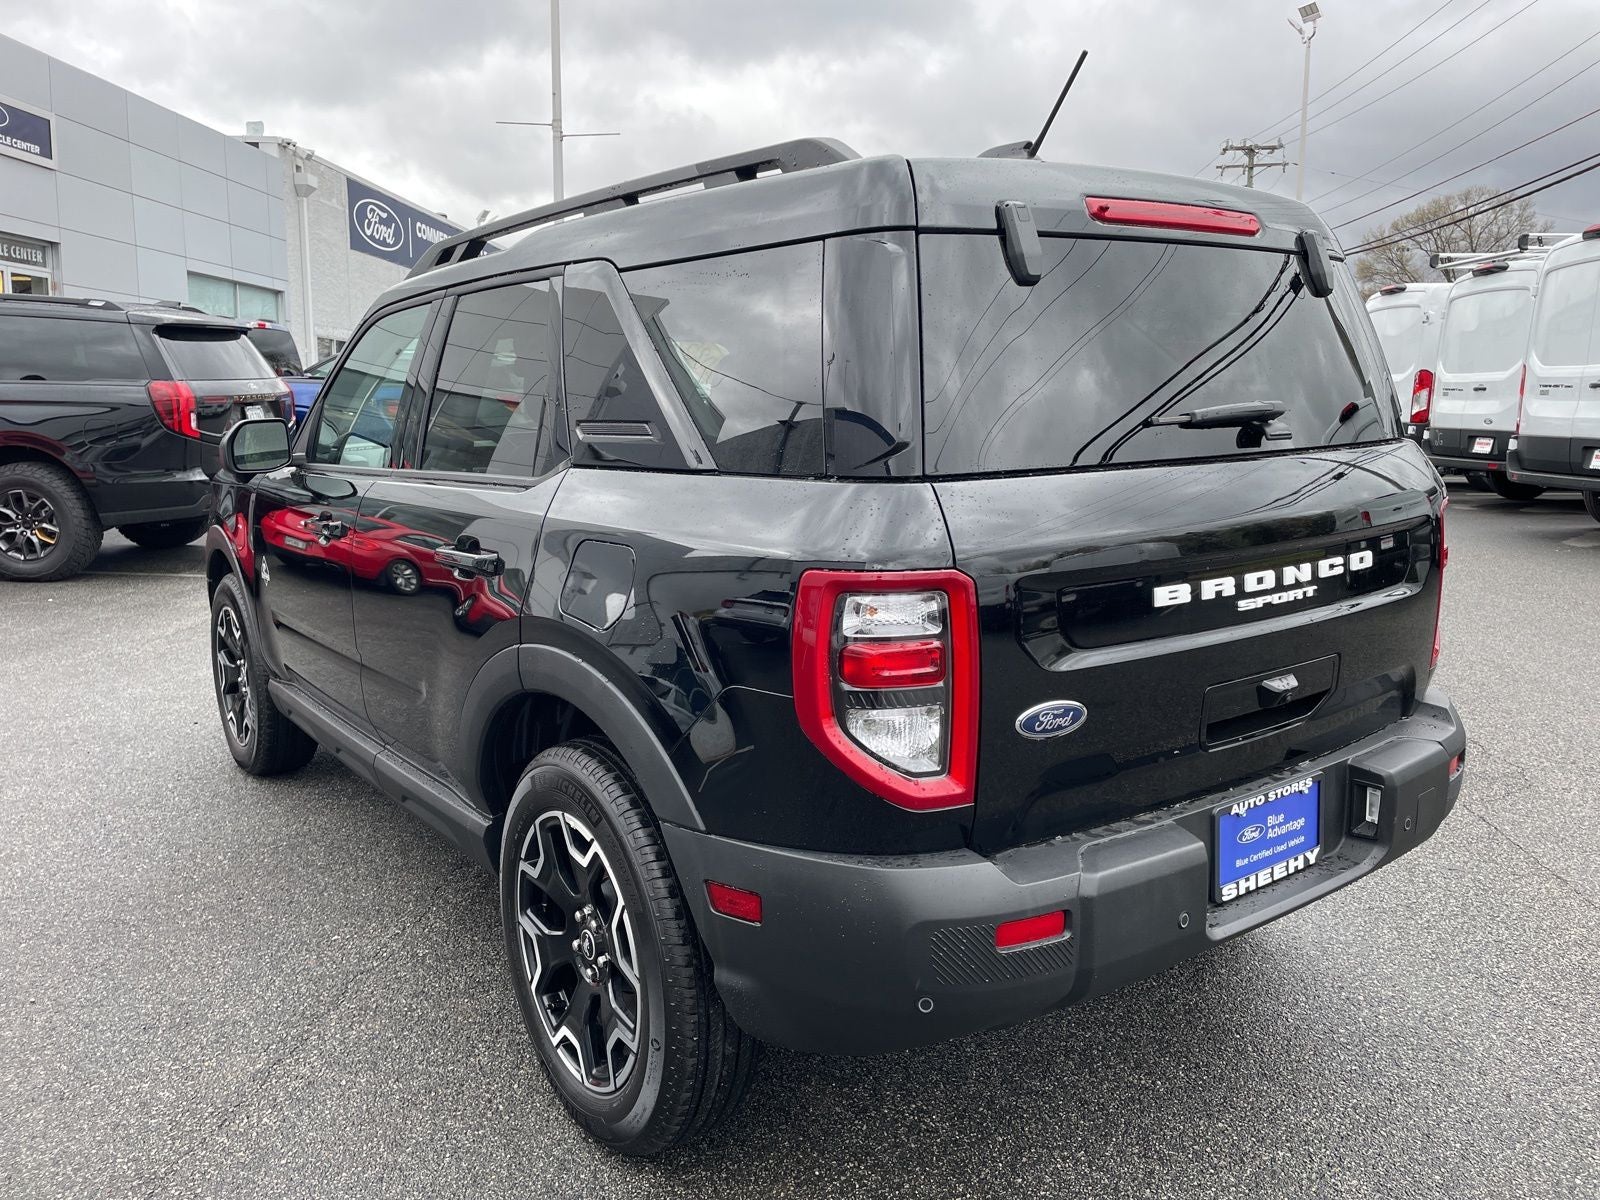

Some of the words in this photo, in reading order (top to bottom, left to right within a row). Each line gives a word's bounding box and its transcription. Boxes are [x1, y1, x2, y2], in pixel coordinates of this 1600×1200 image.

[12, 138, 40, 155] CENTER
[364, 204, 395, 245] Ford
[416, 221, 451, 244] COMME
[10, 245, 43, 263] CENTER
[1153, 550, 1373, 608] BRONCO
[1237, 585, 1318, 612] SPORT
[1034, 708, 1074, 732] Ford
[1230, 795, 1265, 816] AUTO
[1268, 777, 1313, 802] STORES
[1266, 817, 1306, 840] Advantage
[1267, 813, 1285, 827] Blue
[1235, 857, 1249, 868] Blue
[1249, 847, 1273, 863] Certified
[1273, 843, 1287, 853] Used
[1287, 835, 1305, 849] Vehicle
[1221, 847, 1321, 902] SHEEHY
